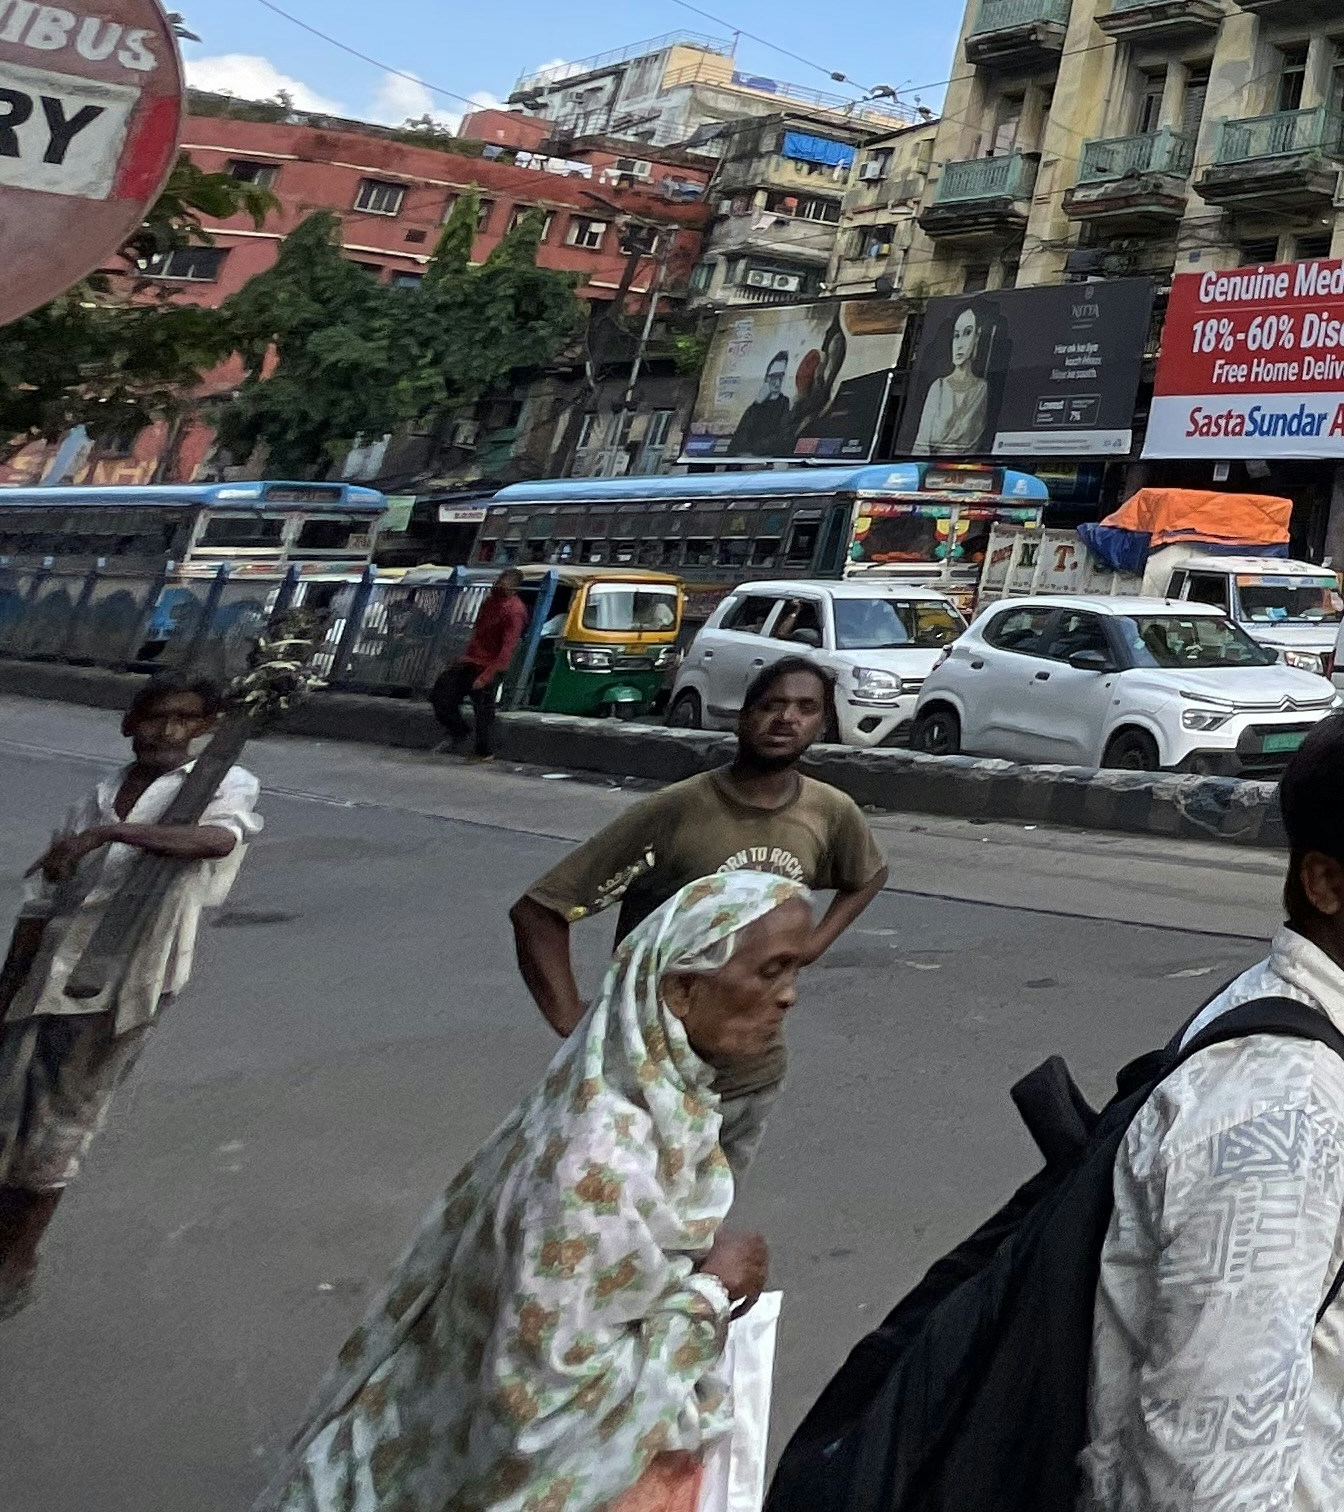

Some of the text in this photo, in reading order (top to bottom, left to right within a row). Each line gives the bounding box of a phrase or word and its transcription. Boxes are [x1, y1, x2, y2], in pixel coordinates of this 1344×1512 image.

[1198, 266, 1289, 303] Genuine
[1192, 313, 1296, 354] 18%-60%
[1212, 358, 1247, 384] Free
[1250, 357, 1299, 383] Home
[1185, 402, 1328, 438] SastaSundar
[717, 850, 748, 873] ORN
[750, 847, 768, 862] TO
